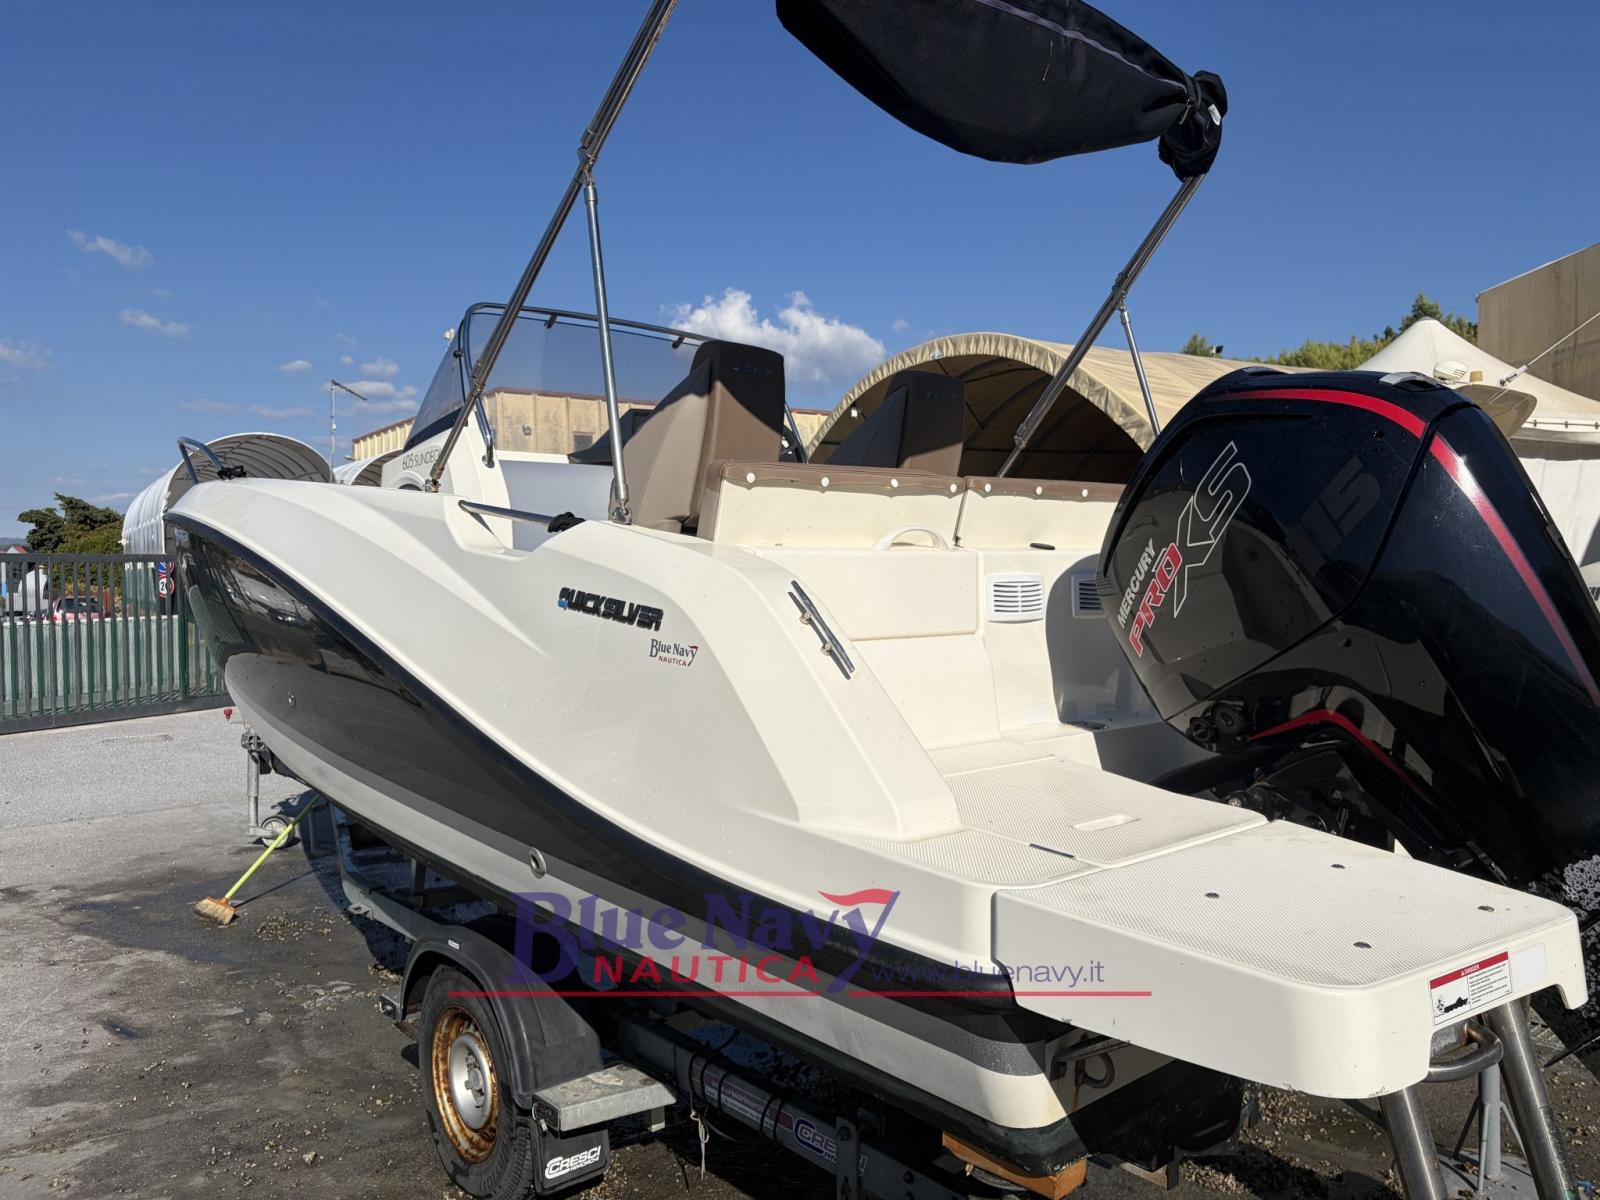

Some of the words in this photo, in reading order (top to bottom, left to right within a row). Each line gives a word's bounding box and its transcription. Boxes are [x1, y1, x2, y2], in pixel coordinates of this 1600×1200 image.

[1117, 538, 1156, 628] MERCURY
[1129, 542, 1183, 657] PRO
[558, 587, 664, 632] QUICKSILVER
[649, 639, 671, 658] Blue
[673, 643, 698, 667] Navy
[658, 655, 687, 667] NAUTICA
[545, 1145, 602, 1179] CRESCI
